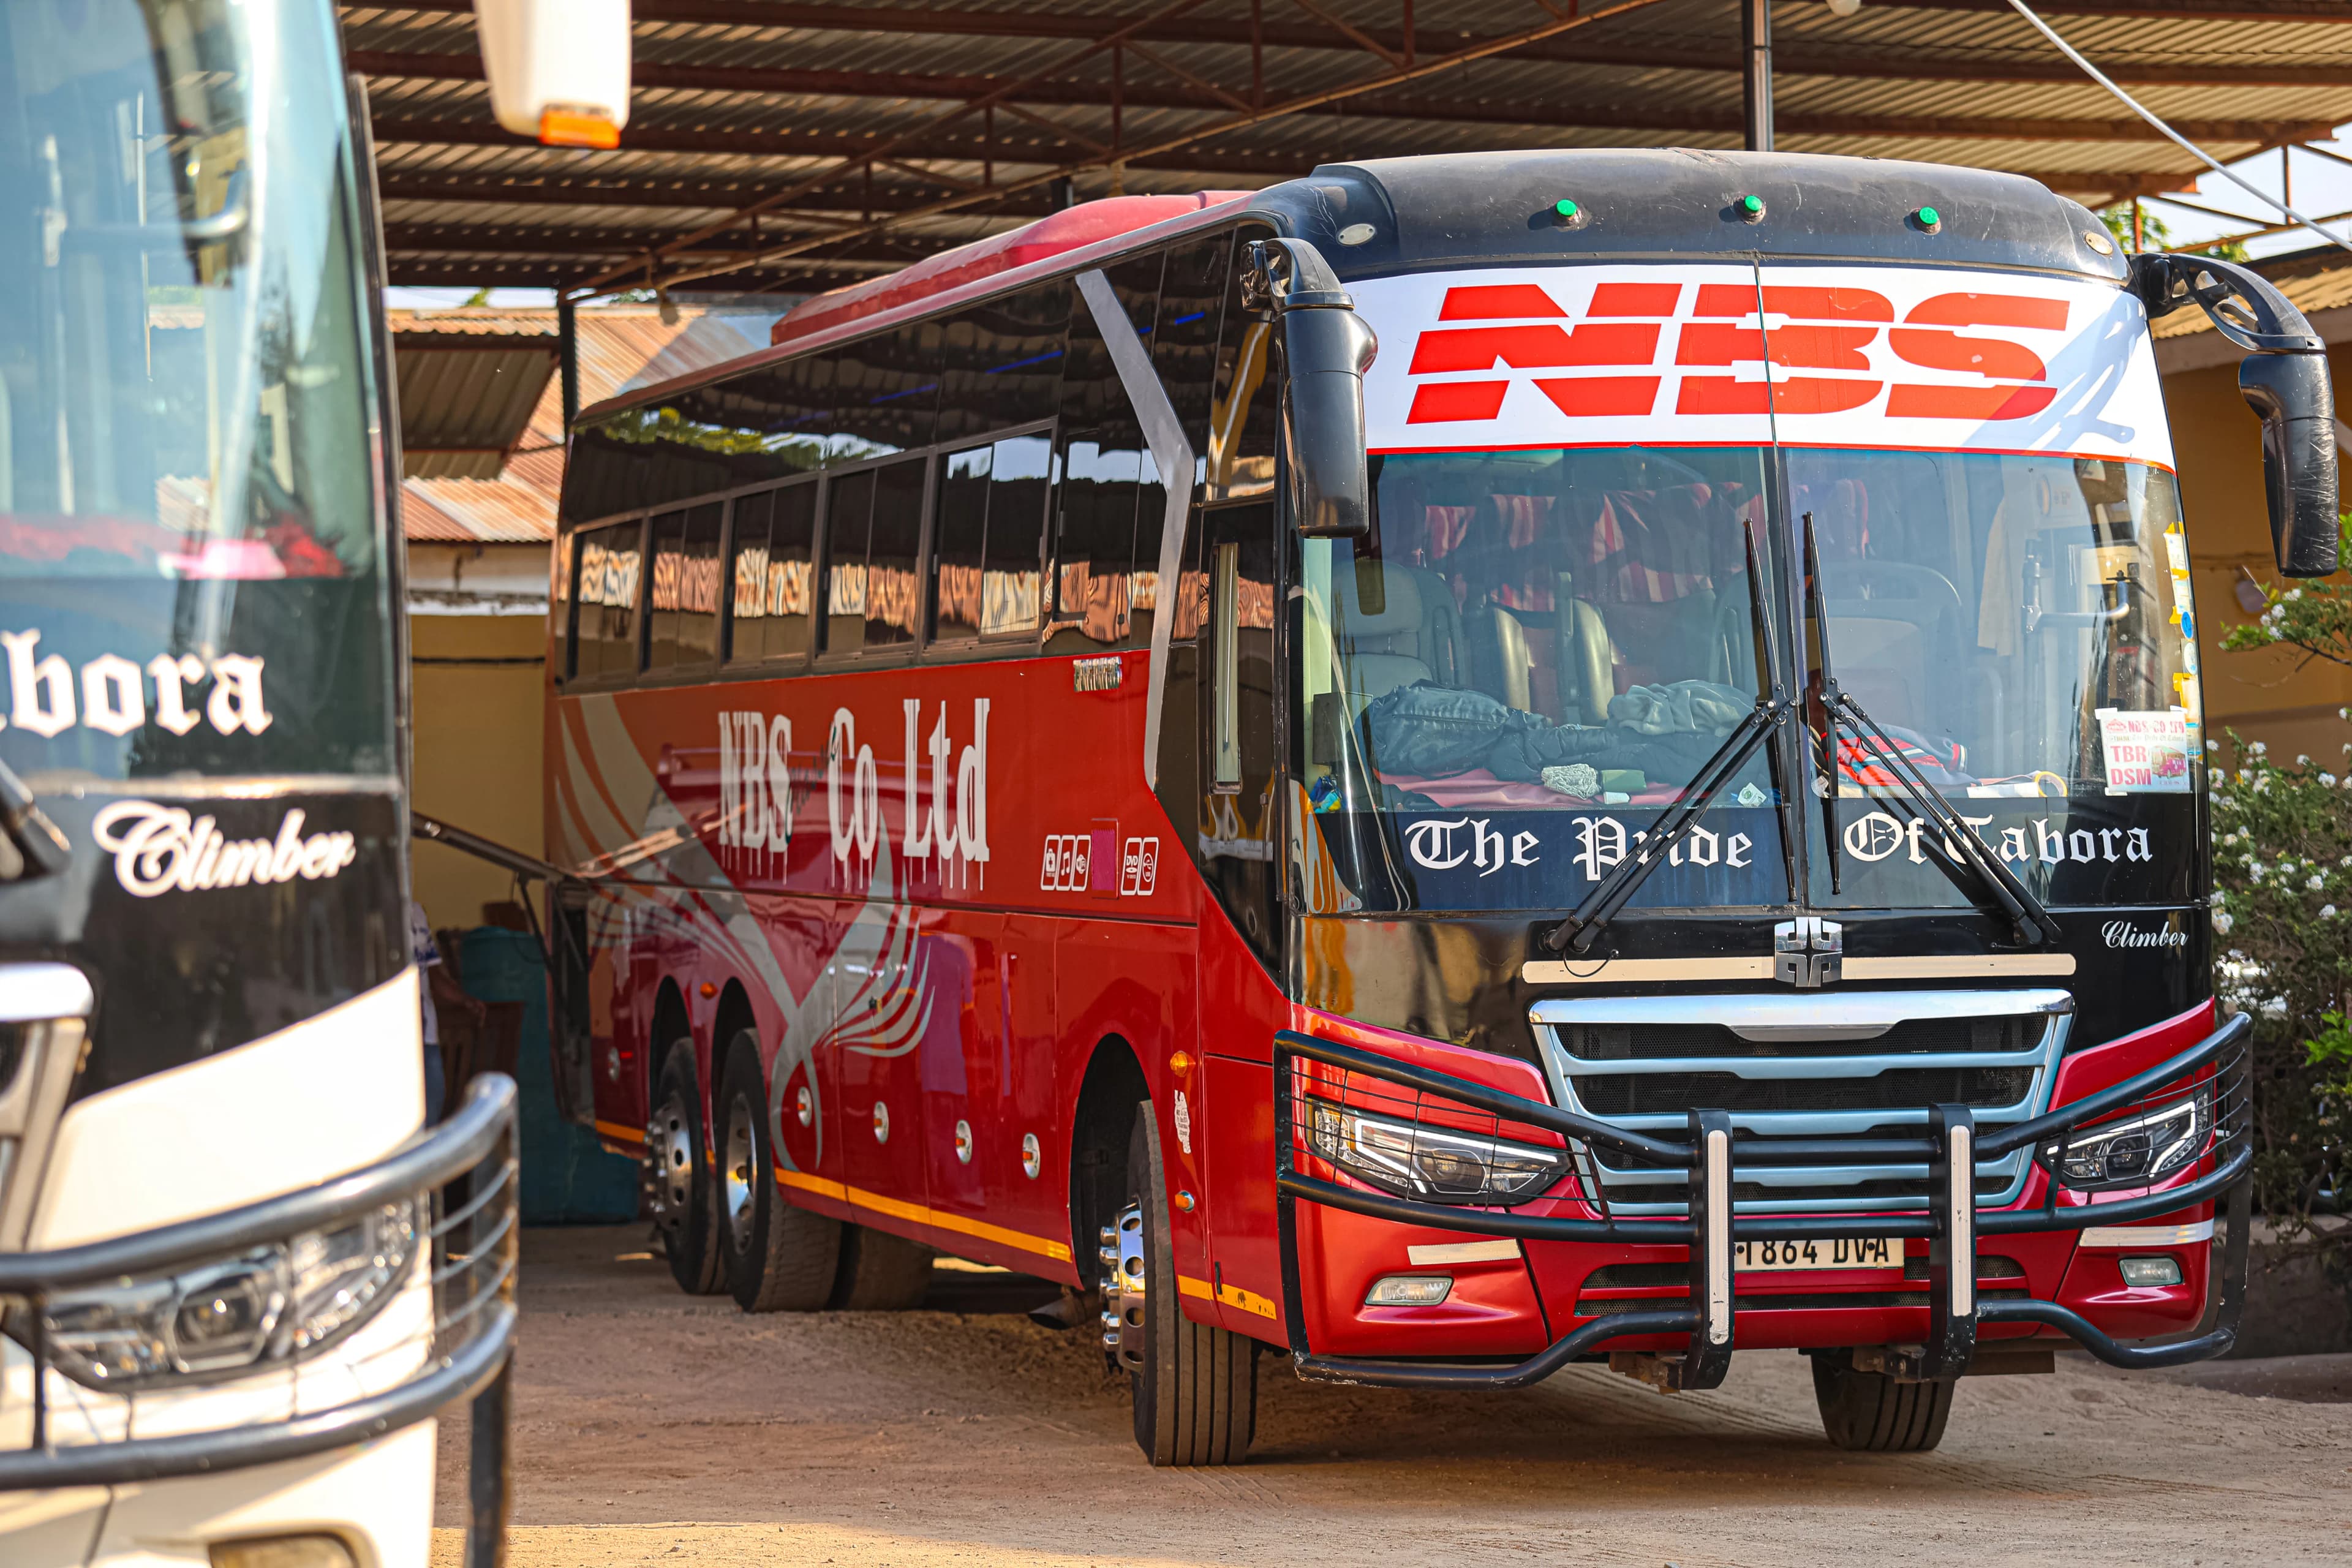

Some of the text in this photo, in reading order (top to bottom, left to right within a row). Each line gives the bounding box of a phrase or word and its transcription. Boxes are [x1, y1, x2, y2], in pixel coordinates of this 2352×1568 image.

[1406, 283, 2070, 424] NBS
[0, 628, 273, 739] bora
[2111, 745, 2147, 763] TBR
[2111, 768, 2152, 786] DSM
[718, 710, 793, 885] NBS
[828, 707, 878, 889] Co
[903, 698, 990, 892] Ltd
[92, 799, 356, 899] Climber
[1404, 816, 1540, 878] The
[1844, 812, 1928, 865] Of
[1939, 813, 2154, 865] Tabora
[2101, 921, 2189, 948] Climber
[1833, 1238, 1888, 1263] DVA
